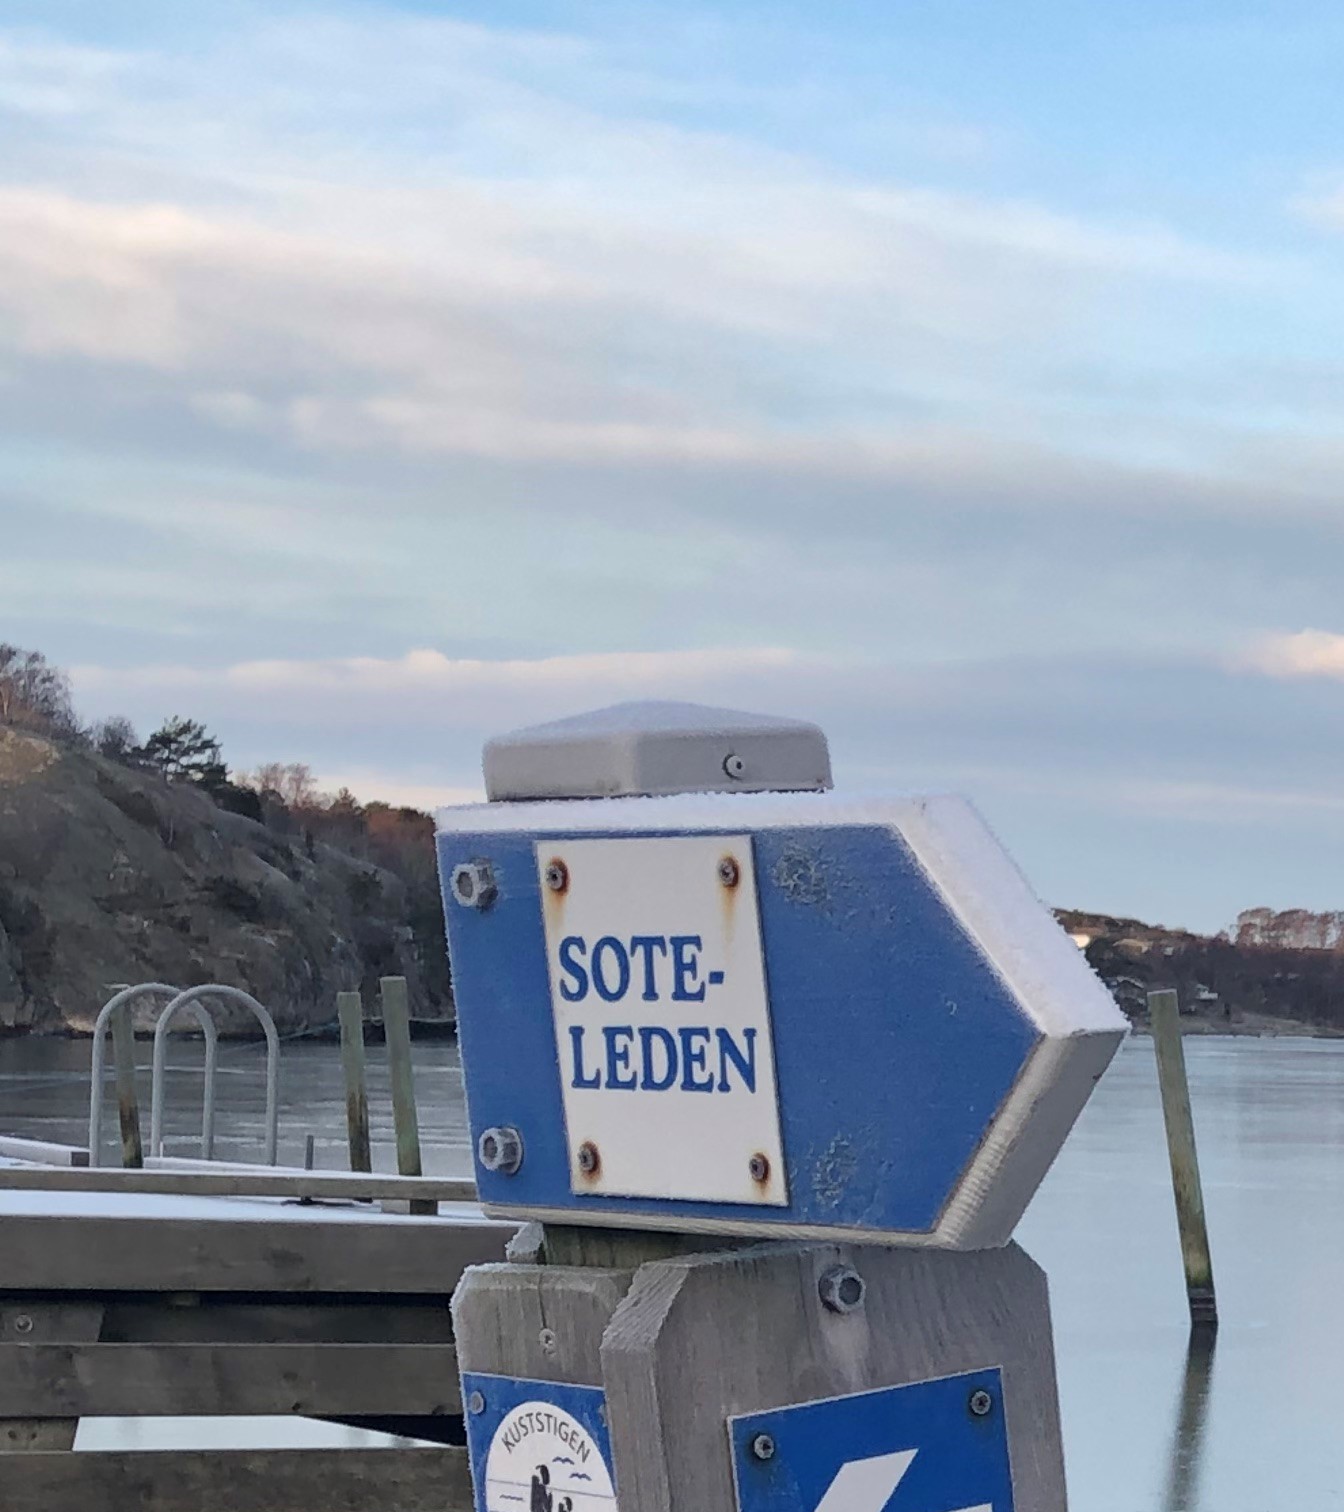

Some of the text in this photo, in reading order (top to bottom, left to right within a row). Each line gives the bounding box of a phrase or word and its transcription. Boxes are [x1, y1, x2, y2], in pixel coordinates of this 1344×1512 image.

[559, 935, 724, 1002] SOTE-
[568, 1025, 757, 1094] LEDEN
[501, 1411, 592, 1464] KUSTSTIGEN
